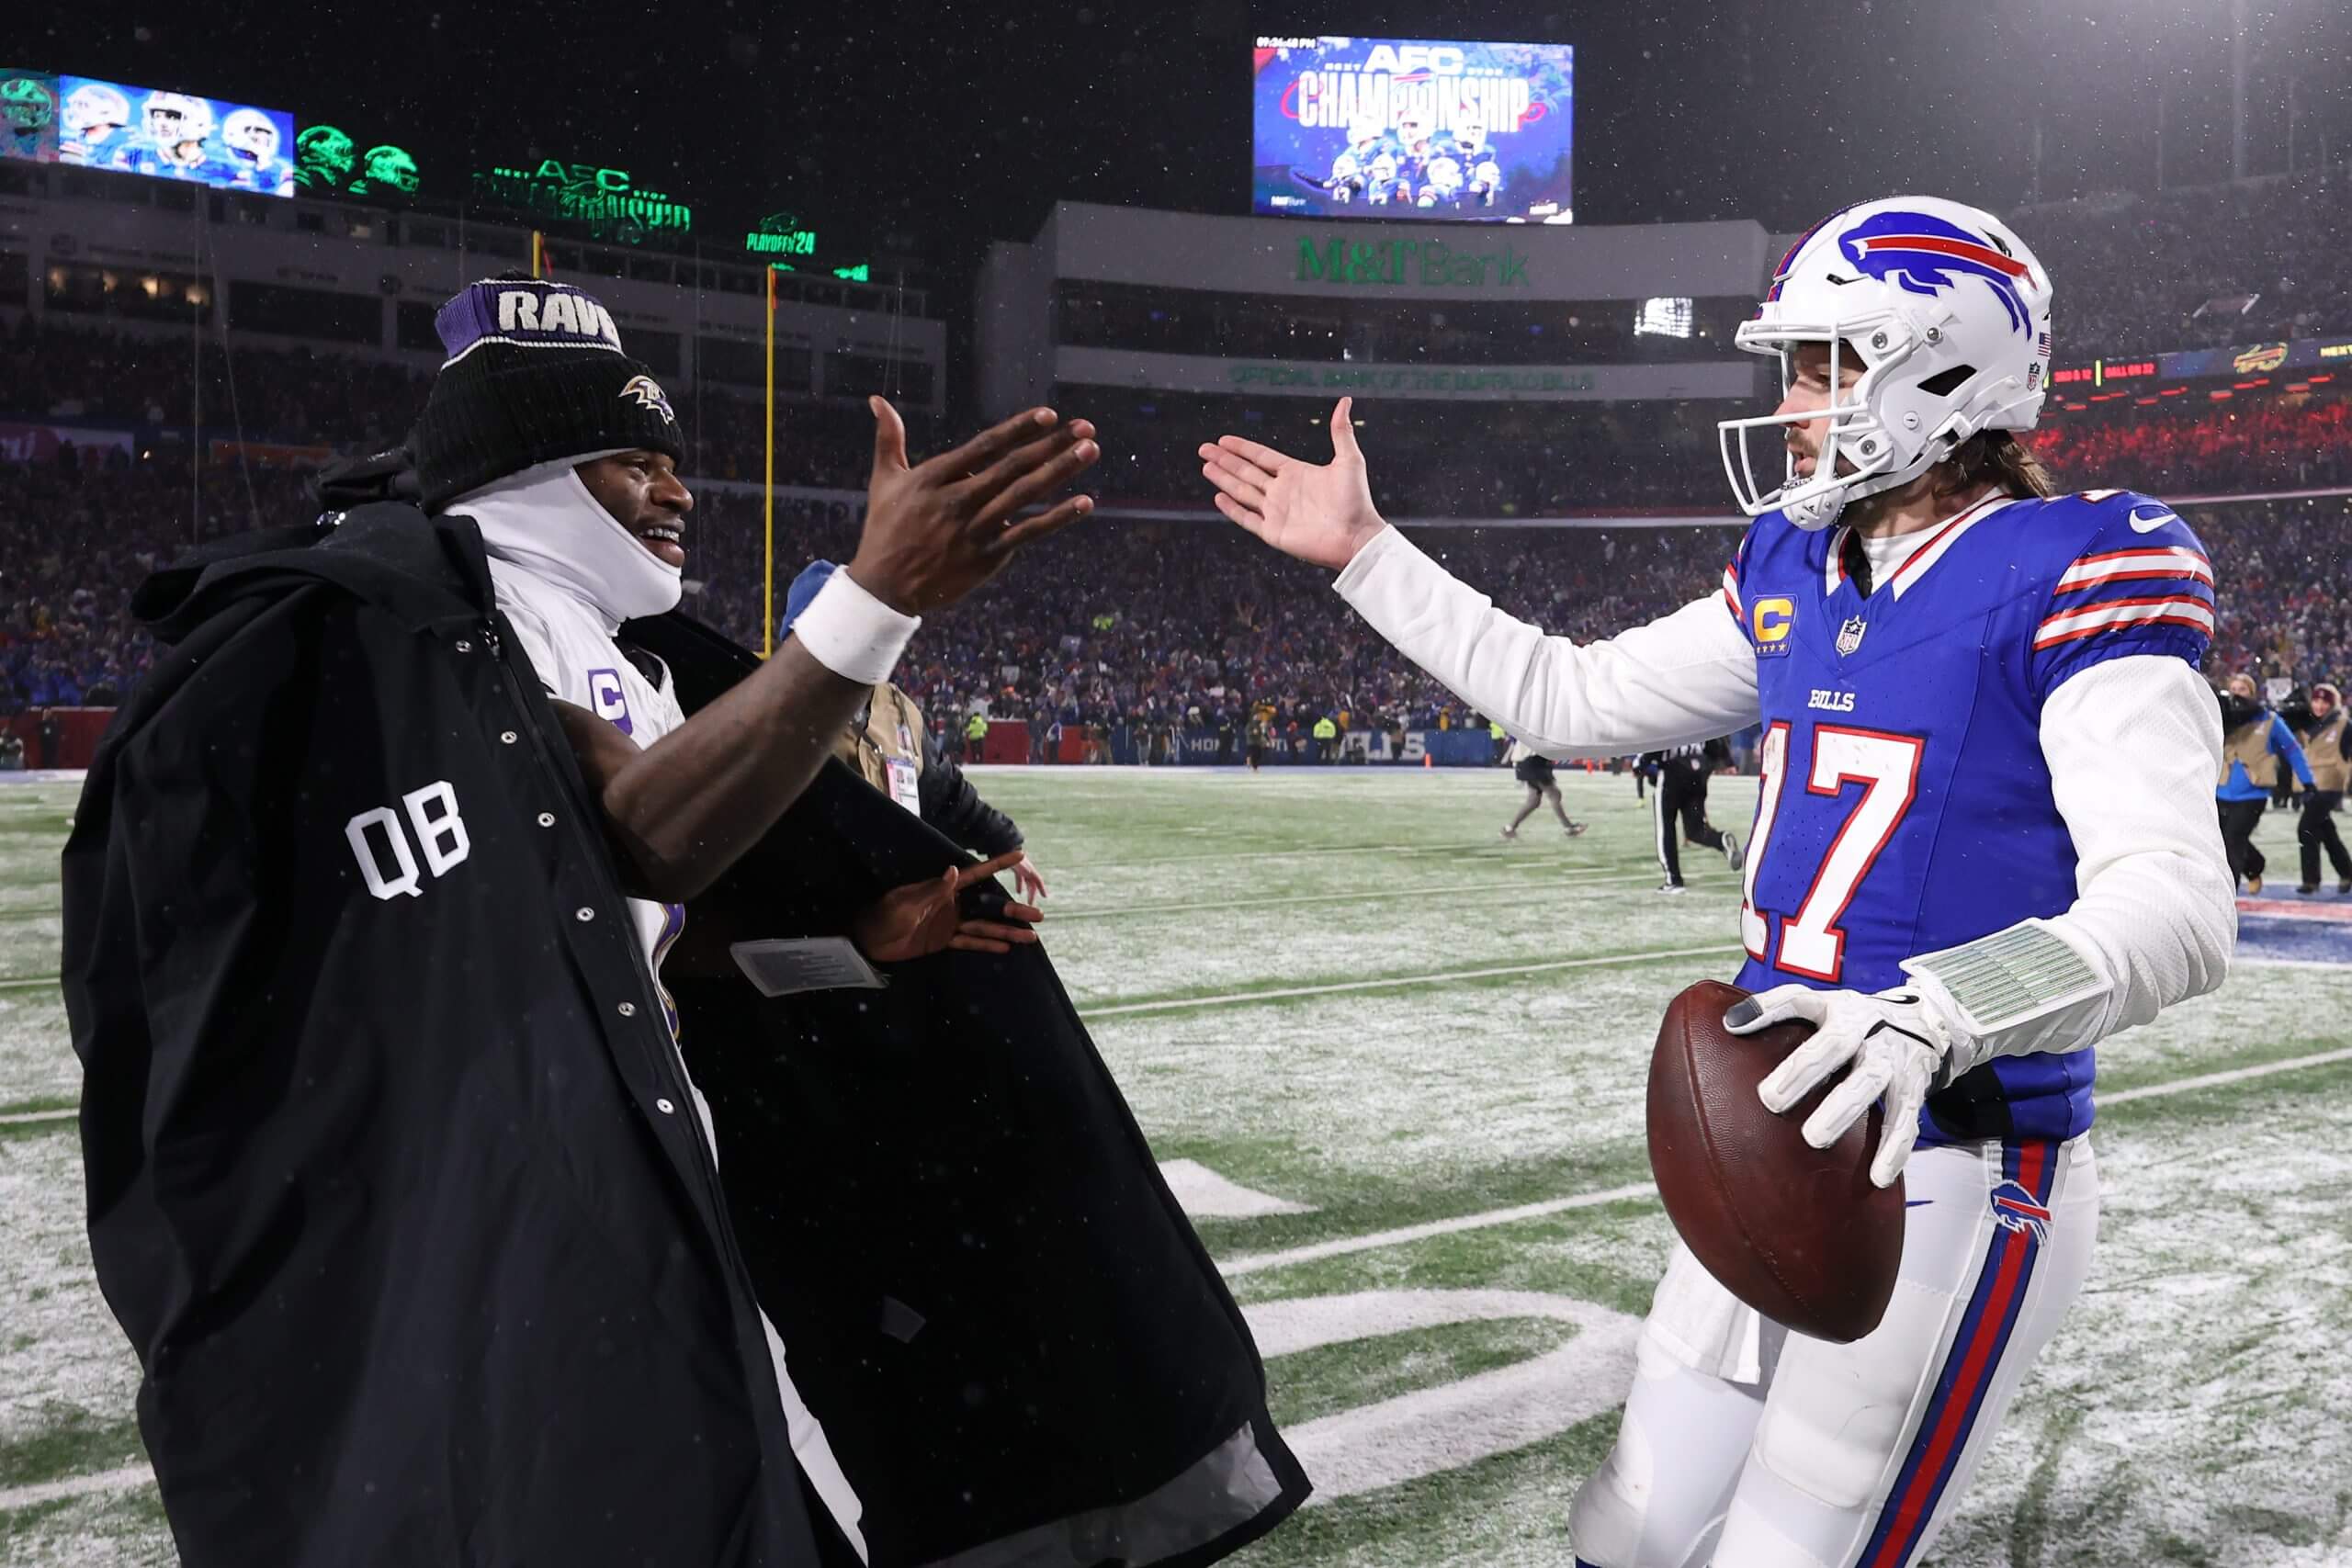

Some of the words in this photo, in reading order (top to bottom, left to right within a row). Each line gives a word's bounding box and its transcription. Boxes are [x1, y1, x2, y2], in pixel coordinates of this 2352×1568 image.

[1363, 45, 1464, 74] AFC
[1295, 235, 1416, 285] M&T
[1421, 241, 1529, 286] Bank
[1754, 597, 1793, 642] C
[592, 672, 627, 721] C
[1807, 689, 1855, 712] BILLS
[345, 779, 471, 901] QB
[1740, 718, 1928, 985] 17
